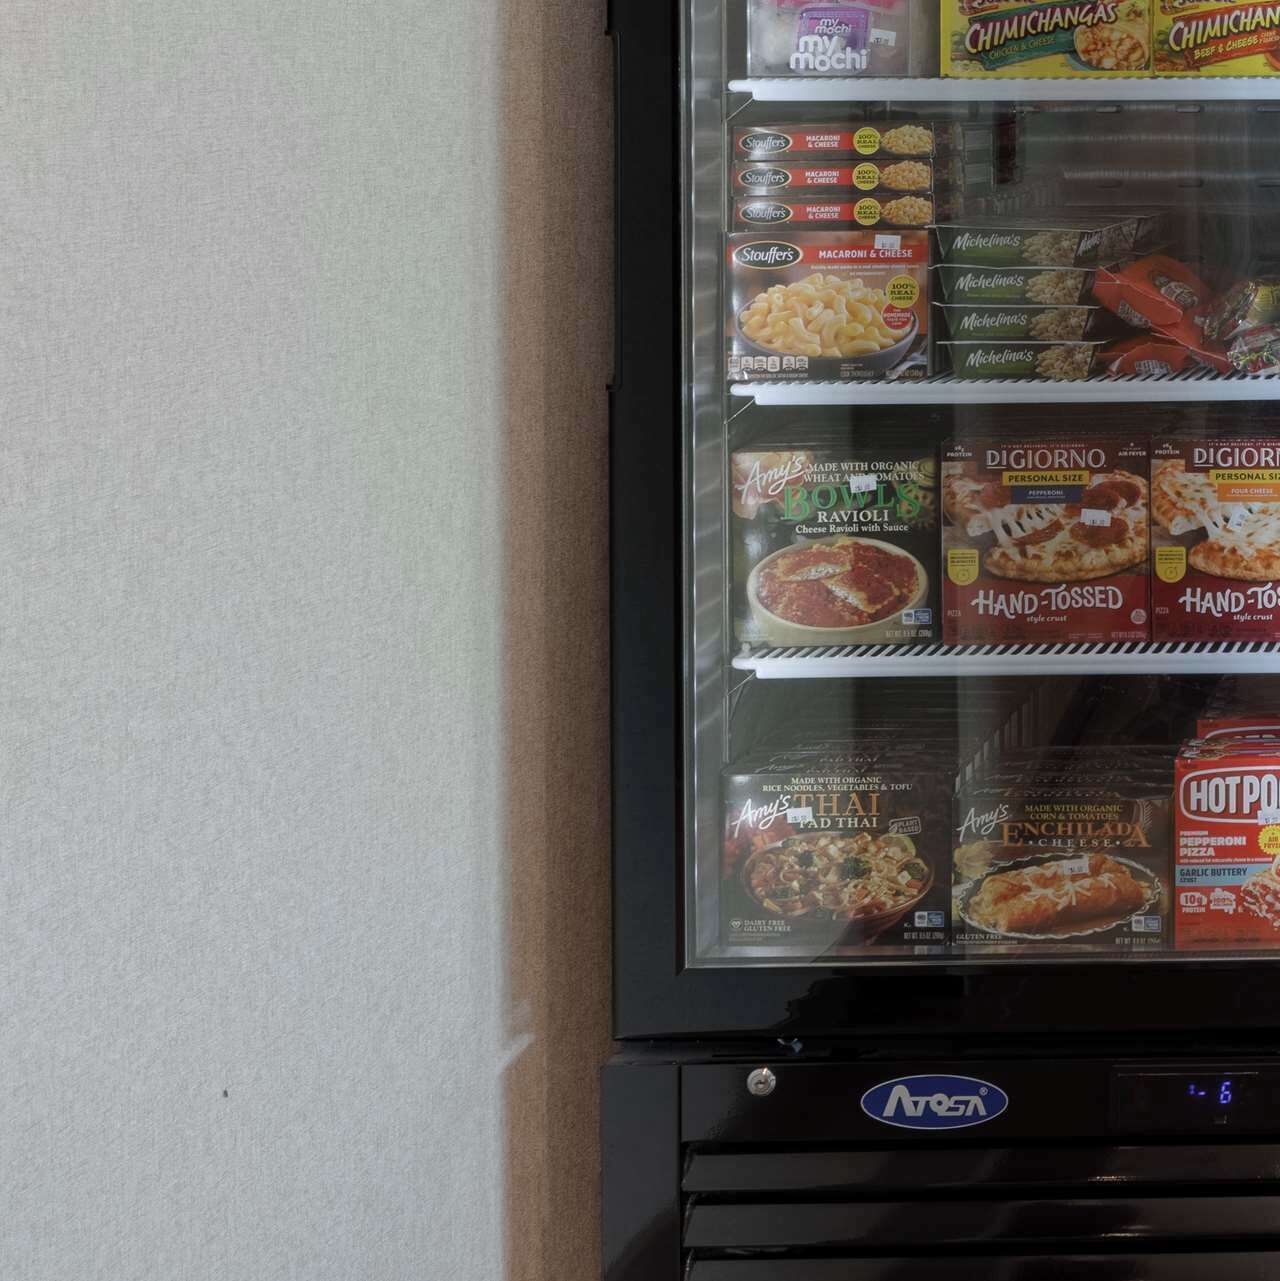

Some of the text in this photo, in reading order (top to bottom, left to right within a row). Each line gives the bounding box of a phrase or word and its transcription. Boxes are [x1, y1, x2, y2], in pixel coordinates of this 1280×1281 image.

[965, 3, 1117, 54] CHIMICHANGAS
[799, 35, 839, 55] my
[790, 47, 867, 71] mochi
[746, 135, 785, 150] Stouffer's
[745, 171, 785, 186] Stouffer's
[746, 207, 786, 221] Stouffer's
[952, 231, 1021, 251] Michelina's
[741, 249, 794, 265] Stouffer's
[955, 271, 1024, 291] Michelina's
[960, 310, 1028, 331] Michelina's
[966, 348, 1034, 368] Michelina's
[735, 456, 806, 504] Amy's
[1008, 474, 1083, 483] PERSONAL SIZE
[1216, 472, 1266, 481] PERSONAL
[783, 484, 921, 520] BOWLS
[817, 510, 889, 523] RAVIOLI
[795, 524, 909, 534] Cheese Ravioli with Sauce
[970, 583, 1124, 620] HAND-TOSSED
[794, 793, 880, 816] THAI
[1190, 776, 1241, 814] HOT
[726, 794, 793, 838] Amy's
[800, 818, 877, 829] PAD THAI
[956, 803, 1010, 842] Amy's
[1001, 822, 1152, 848] ENCHILADA
[1180, 837, 1247, 846] PEPPERONI
[1180, 848, 1215, 856] PIZZA
[1180, 868, 1248, 877] GARLIC BUTTERY
